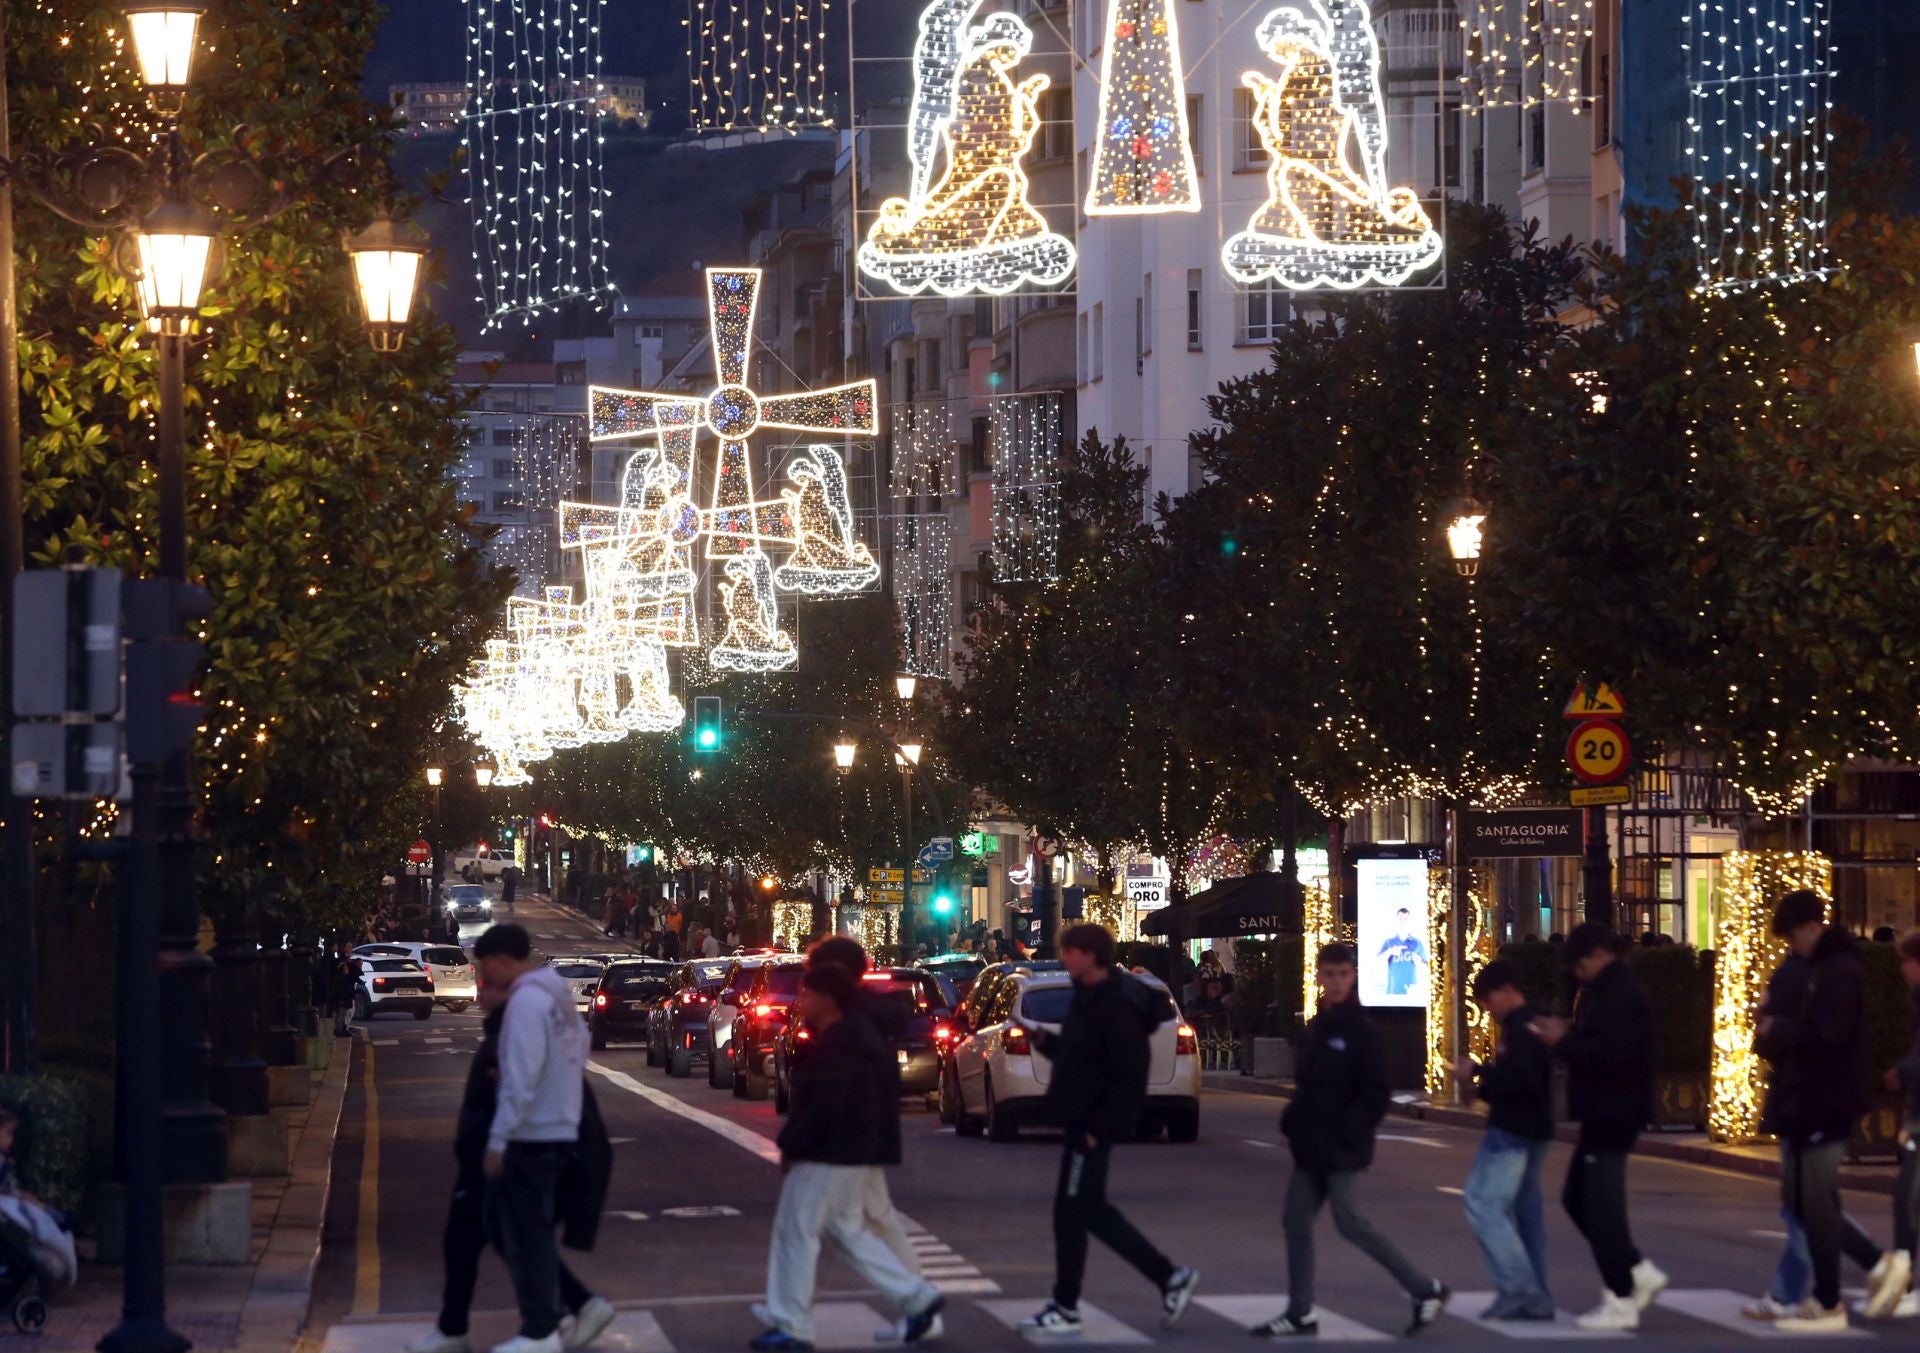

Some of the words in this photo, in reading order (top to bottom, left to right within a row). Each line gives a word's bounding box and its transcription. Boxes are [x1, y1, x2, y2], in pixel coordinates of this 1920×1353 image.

[1583, 740, 1615, 760] 20
[1476, 825, 1568, 837] SANTAGLORIA
[1133, 891, 1160, 902] ORO
[1239, 915, 1281, 928] SANT
